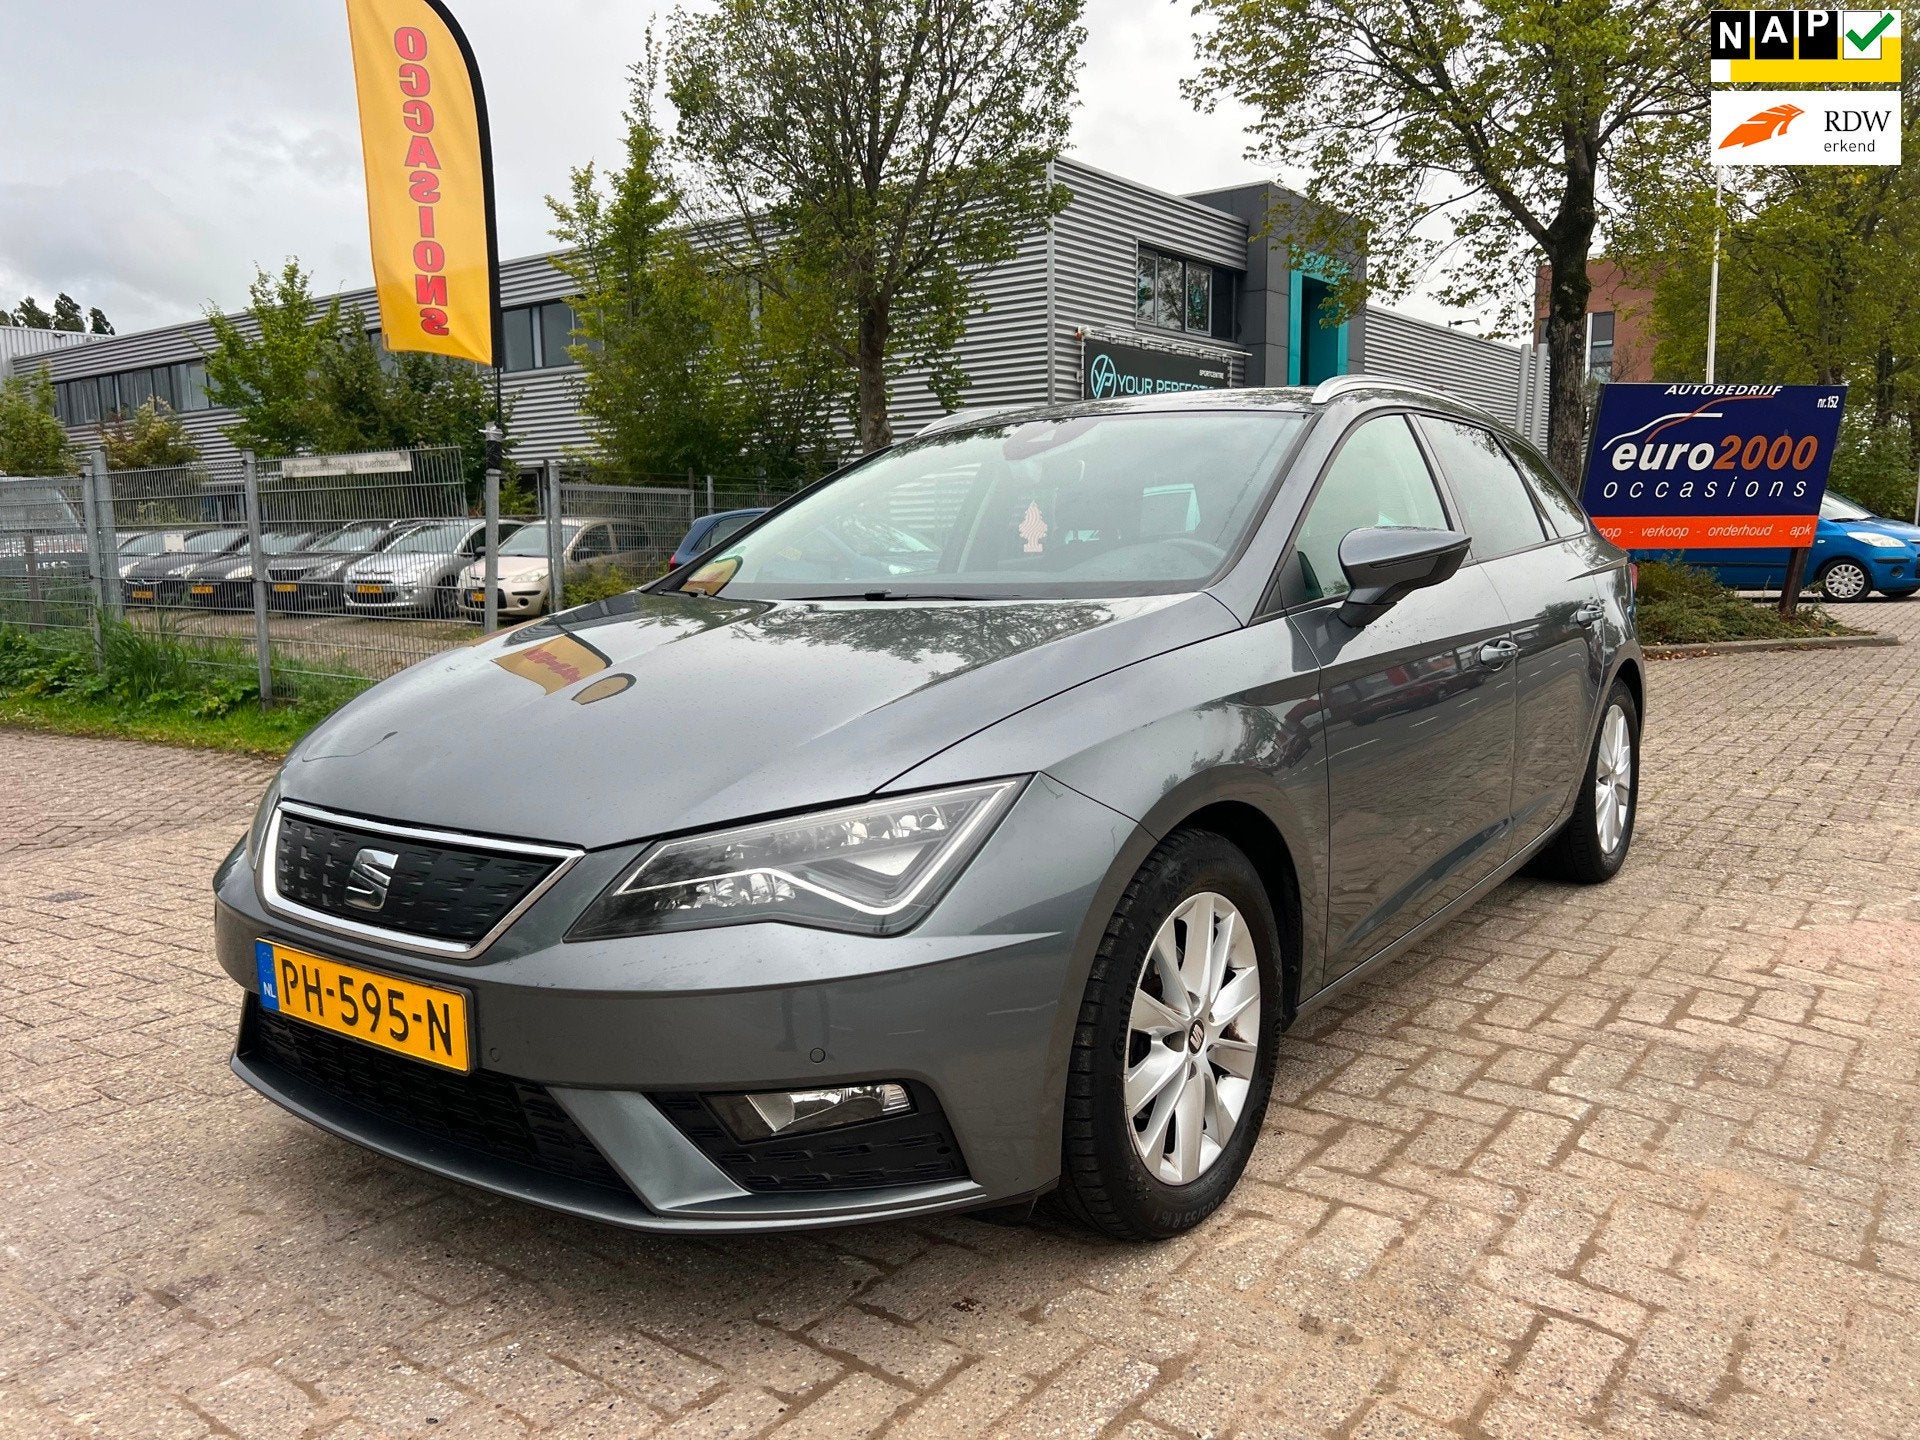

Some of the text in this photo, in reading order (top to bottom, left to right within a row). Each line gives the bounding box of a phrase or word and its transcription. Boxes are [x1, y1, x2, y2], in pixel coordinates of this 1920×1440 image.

[1117, 374, 1153, 394] YOUR
[1664, 384, 1783, 396] AUTOBEDRIJF
[1817, 395, 1839, 409] nr.152
[1611, 434, 1819, 471] euro2000
[1603, 476, 1807, 498] occasions
[1641, 526, 1689, 539] verkoop
[1707, 525, 1773, 538] onderhoud
[1789, 524, 1811, 539] apk
[263, 981, 277, 999] NL
[281, 958, 452, 1056] PH-595-N
